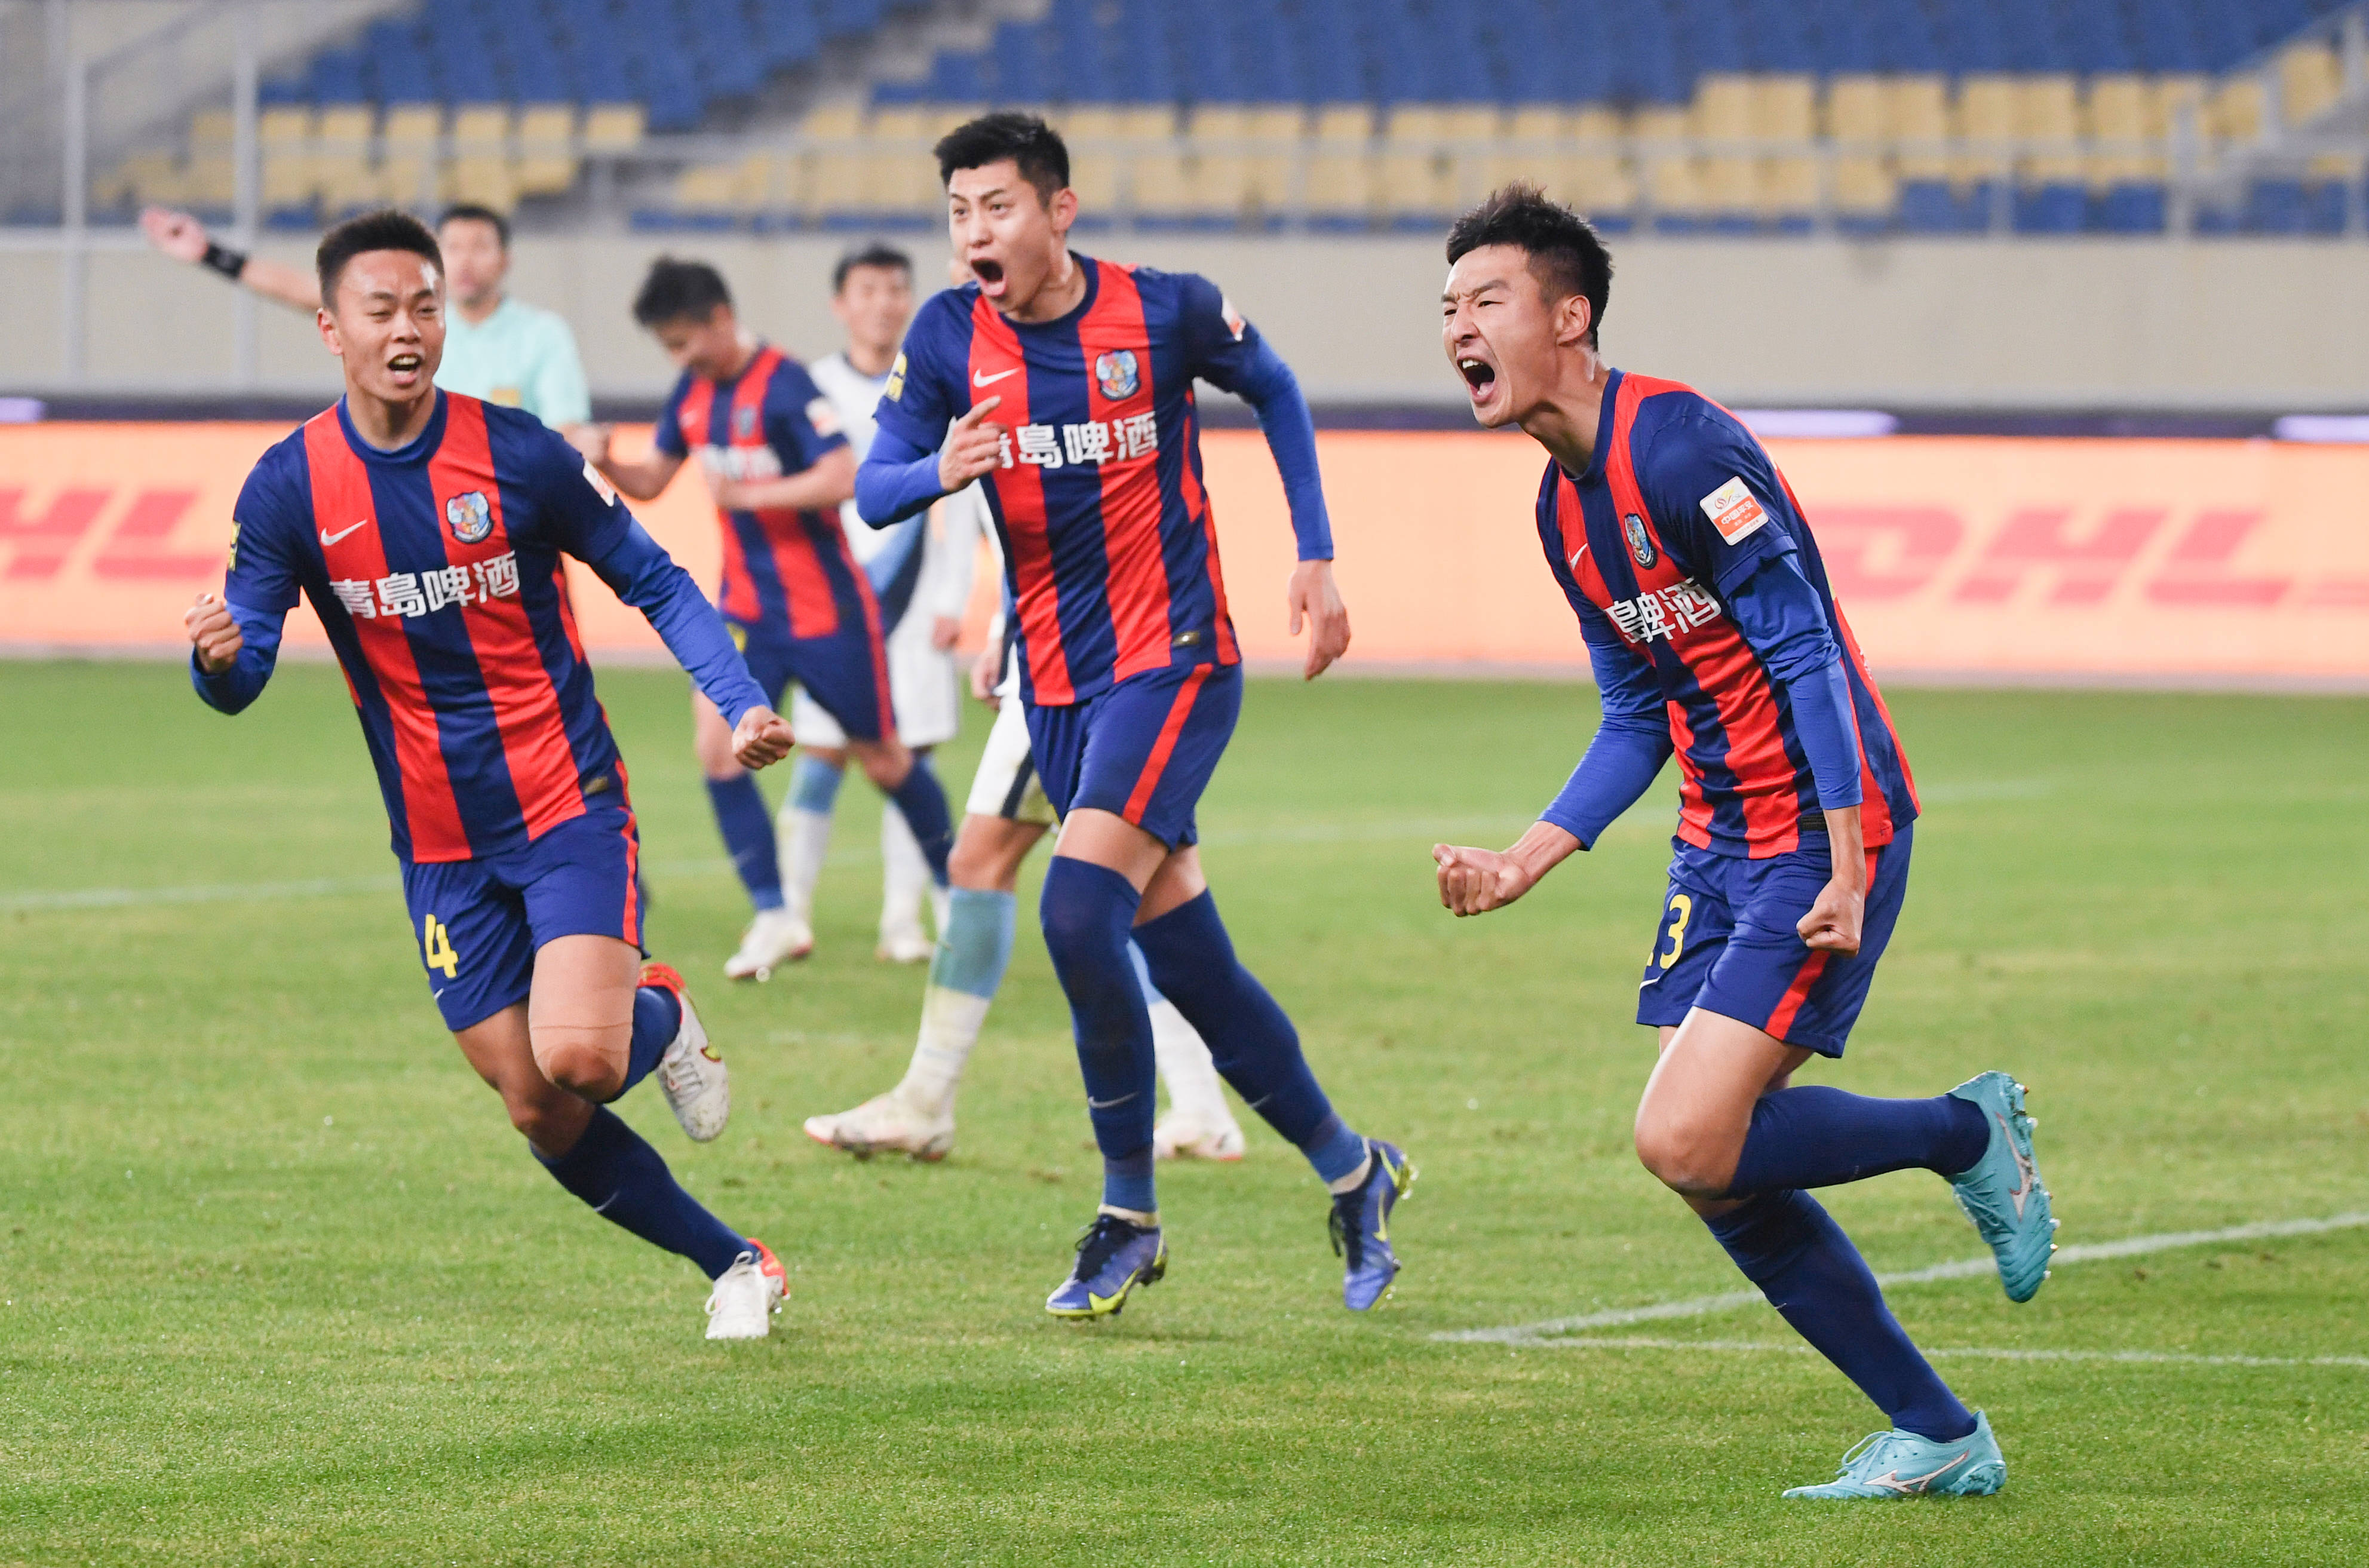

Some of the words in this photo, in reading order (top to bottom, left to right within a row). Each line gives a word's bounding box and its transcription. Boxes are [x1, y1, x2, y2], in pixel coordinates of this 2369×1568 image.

[1805, 506, 2291, 605] DHL
[425, 913, 459, 978] 4
[1646, 894, 1692, 969] 3
